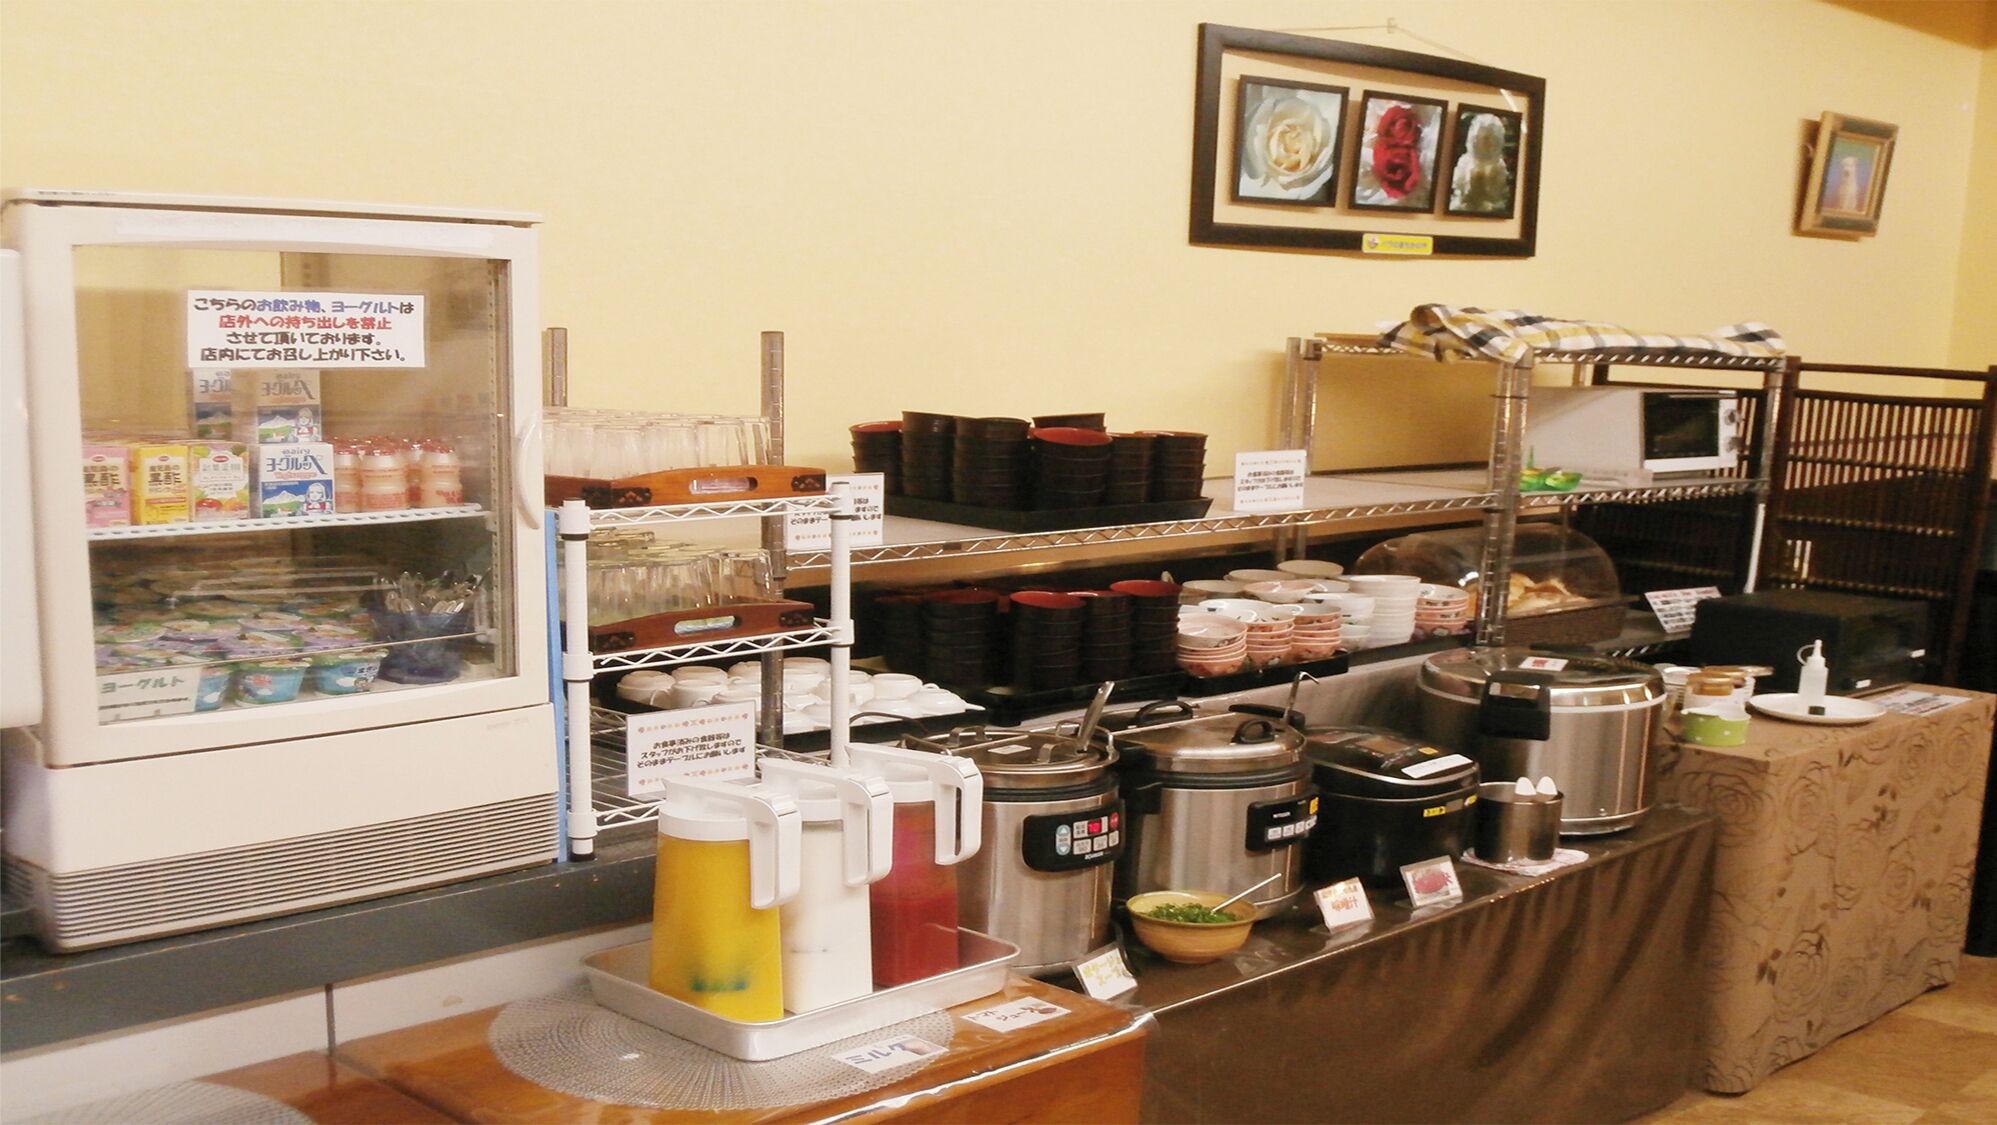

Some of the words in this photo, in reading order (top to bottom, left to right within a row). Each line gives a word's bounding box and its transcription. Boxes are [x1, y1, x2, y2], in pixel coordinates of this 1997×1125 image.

[194, 297, 415, 314] こちらのお飲み物、ヨーグルトは
[219, 315, 392, 330] 店外への持ち出しを禁止
[226, 331, 382, 346] させて頂いております。
[201, 348, 406, 362] 店内にてお召し上がり下さい。
[101, 676, 185, 694] ヨーグルト
[845, 1042, 909, 1065] ミルク
